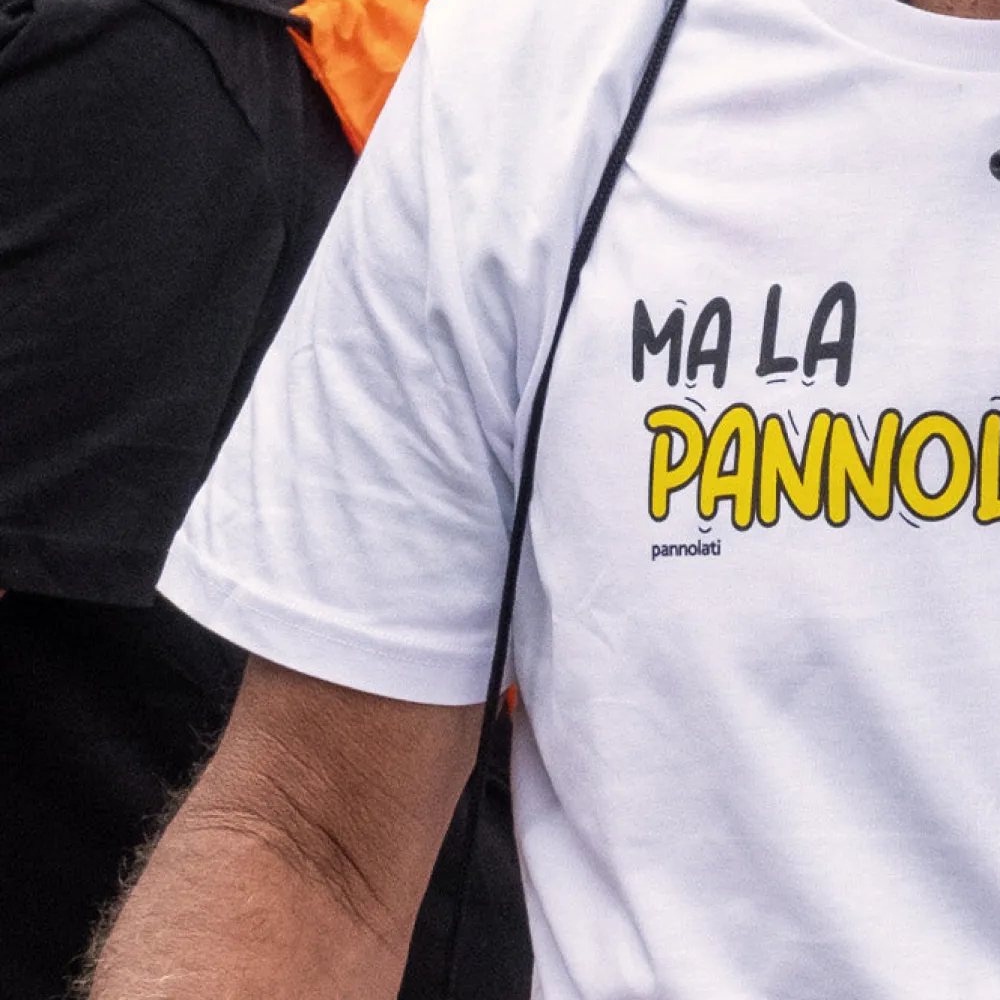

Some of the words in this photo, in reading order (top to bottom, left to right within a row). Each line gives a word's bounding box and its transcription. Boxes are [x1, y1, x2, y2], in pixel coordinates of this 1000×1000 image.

[632, 296, 732, 389] MA
[755, 280, 857, 387] LA
[651, 539, 722, 561] pannolati
